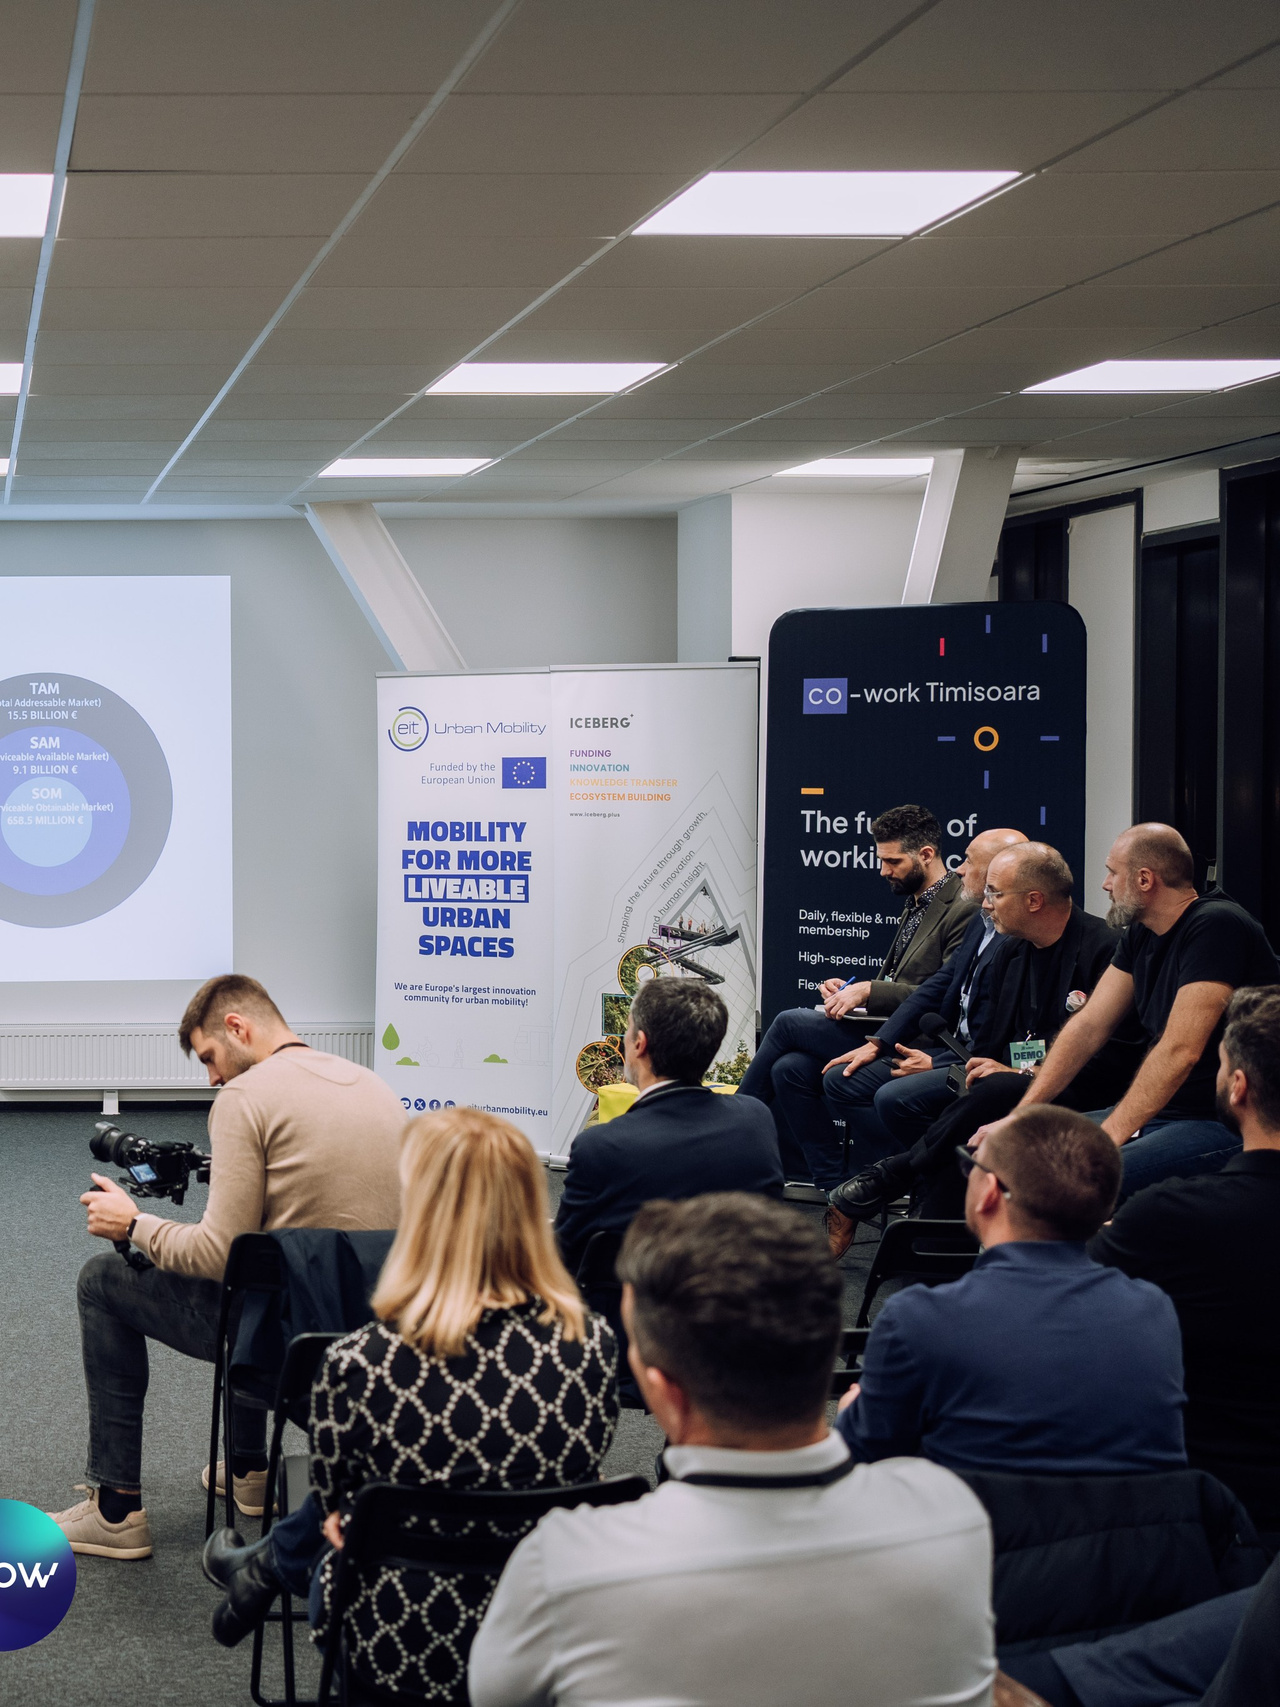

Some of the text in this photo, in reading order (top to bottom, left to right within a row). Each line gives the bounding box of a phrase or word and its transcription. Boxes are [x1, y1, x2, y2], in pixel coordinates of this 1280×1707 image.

[29, 682, 59, 695] TAM
[925, 681, 1040, 702] Timisoara
[14, 698, 66, 707] Addressable
[68, 698, 102, 708] Market)
[8, 710, 78, 720] 15.5 BILLION €
[397, 721, 546, 736] eit Urban Mobility
[30, 736, 60, 749] SAM
[36, 752, 74, 761] Available
[76, 752, 109, 762] Market)
[570, 749, 611, 757] FUNDING
[13, 765, 78, 774] 9.1 BILLION €
[430, 763, 495, 773] Funded by the
[570, 764, 630, 772] INNOVATION
[421, 776, 496, 786] European Union
[570, 778, 678, 787] KNOWLEDGE TRANSFER
[32, 787, 62, 800] SOM
[570, 793, 671, 801] ECOSYSTEM BUILDING
[36, 803, 79, 812] Obtainable
[81, 802, 114, 812] Market)
[35, 815, 75, 825] MILLION
[77, 815, 84, 824] €
[569, 811, 620, 819] www.iceberg.plus
[800, 810, 848, 834] The
[946, 813, 978, 837] of
[407, 821, 527, 842] MOBILITY
[402, 849, 532, 871] FOR MORE
[800, 845, 882, 869] worki
[617, 810, 708, 943] Shaping the future through growth,
[659, 849, 695, 891] innovation
[408, 877, 525, 901] LIVEABLE
[422, 906, 510, 929] URBAN
[651, 915, 660, 934] and
[658, 888, 684, 916] human
[799, 909, 829, 923] Daily,
[831, 911, 872, 923] flexible
[874, 913, 883, 924] &
[799, 925, 870, 940] membership
[418, 935, 514, 958] SPACES
[798, 951, 867, 966] High-speed
[394, 982, 408, 991] We
[425, 983, 459, 993] Europe's
[461, 985, 490, 995] largest
[492, 986, 537, 996] innovation
[404, 994, 529, 1008] community for urban mobility!
[1013, 1050, 1044, 1061] DEMO
